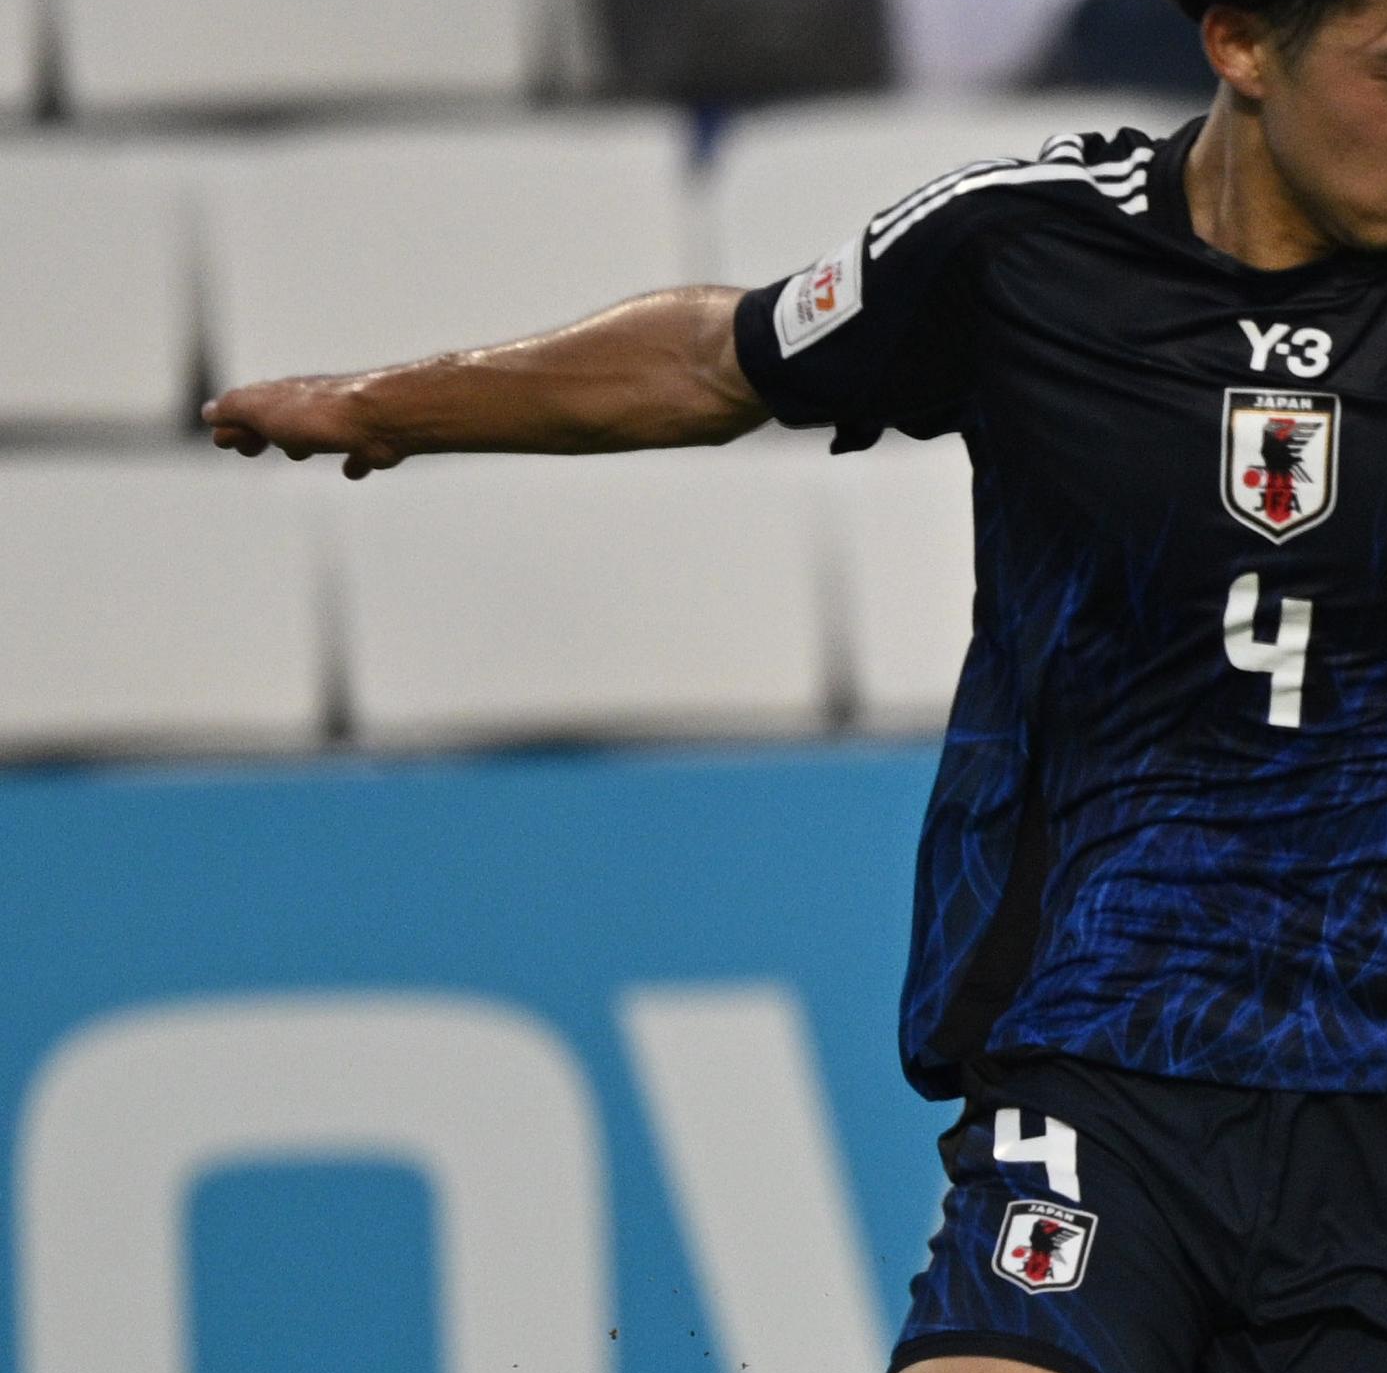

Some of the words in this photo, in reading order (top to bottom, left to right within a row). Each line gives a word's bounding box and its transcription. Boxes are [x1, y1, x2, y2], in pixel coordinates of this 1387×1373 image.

[1237, 319, 1333, 378] Y-3
[1253, 396, 1312, 411] JAPAN
[1223, 572, 1313, 728] 4
[993, 1108, 1081, 1203] 4
[1028, 1204, 1075, 1223] JAPAN
